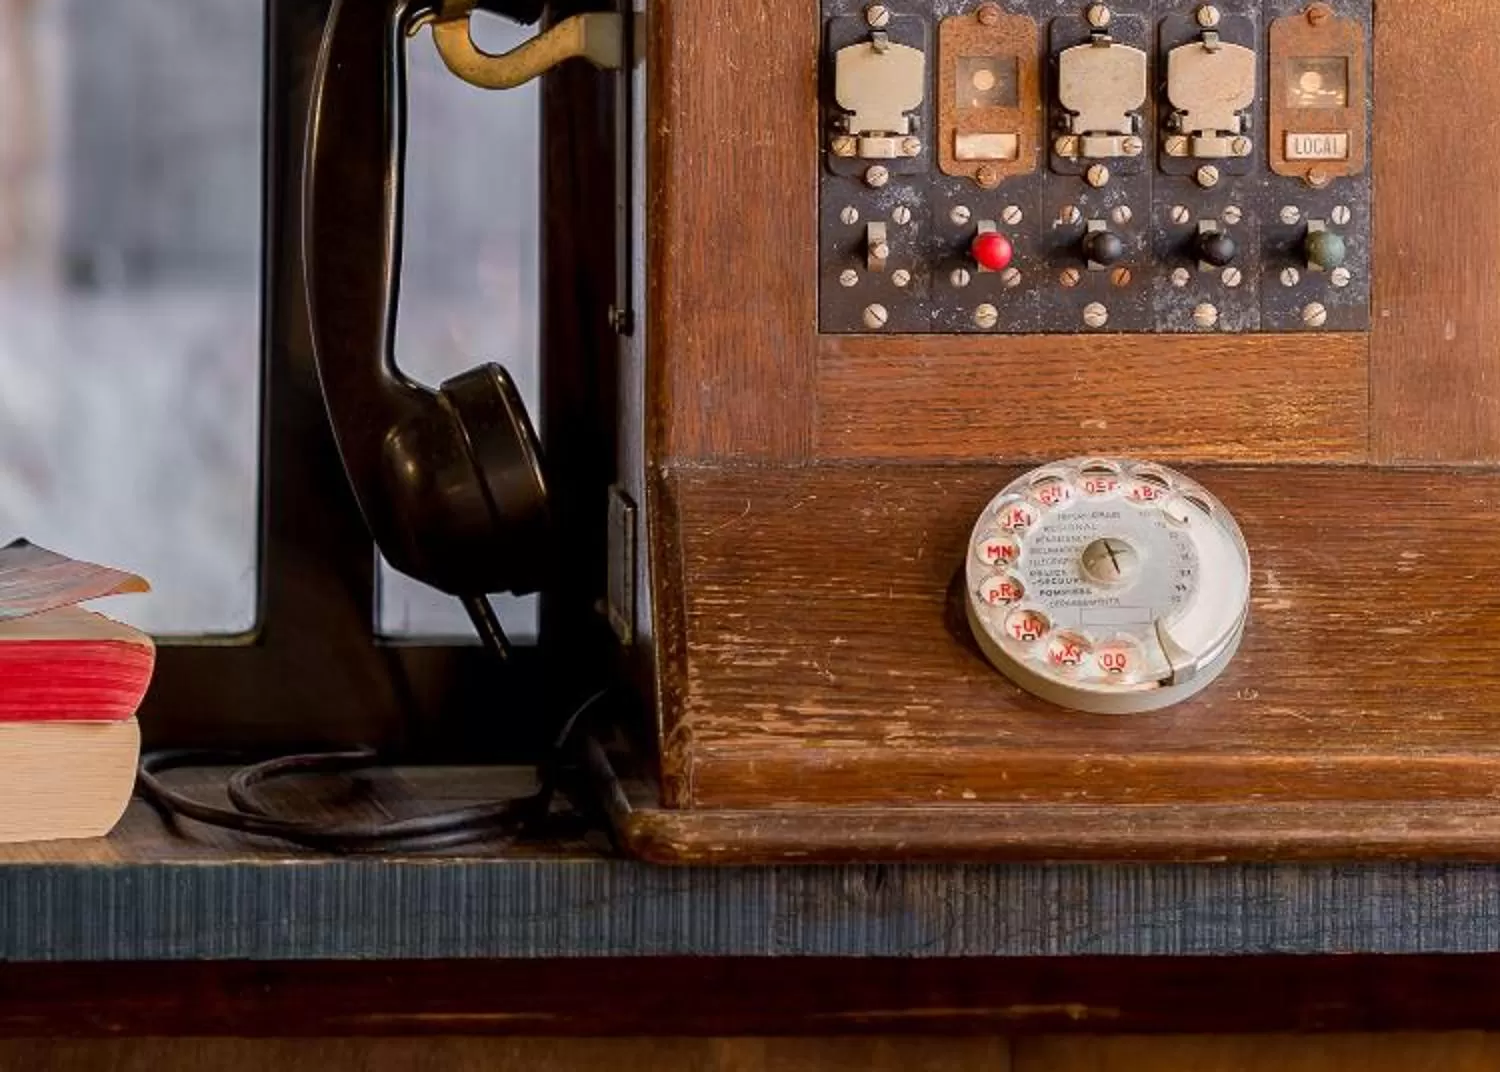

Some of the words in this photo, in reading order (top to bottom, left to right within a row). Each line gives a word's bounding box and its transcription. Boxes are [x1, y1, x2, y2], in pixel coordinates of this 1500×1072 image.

[1294, 136, 1338, 156] LOCAL
[986, 545, 1013, 557] MN
[1049, 643, 1082, 666] WXY
